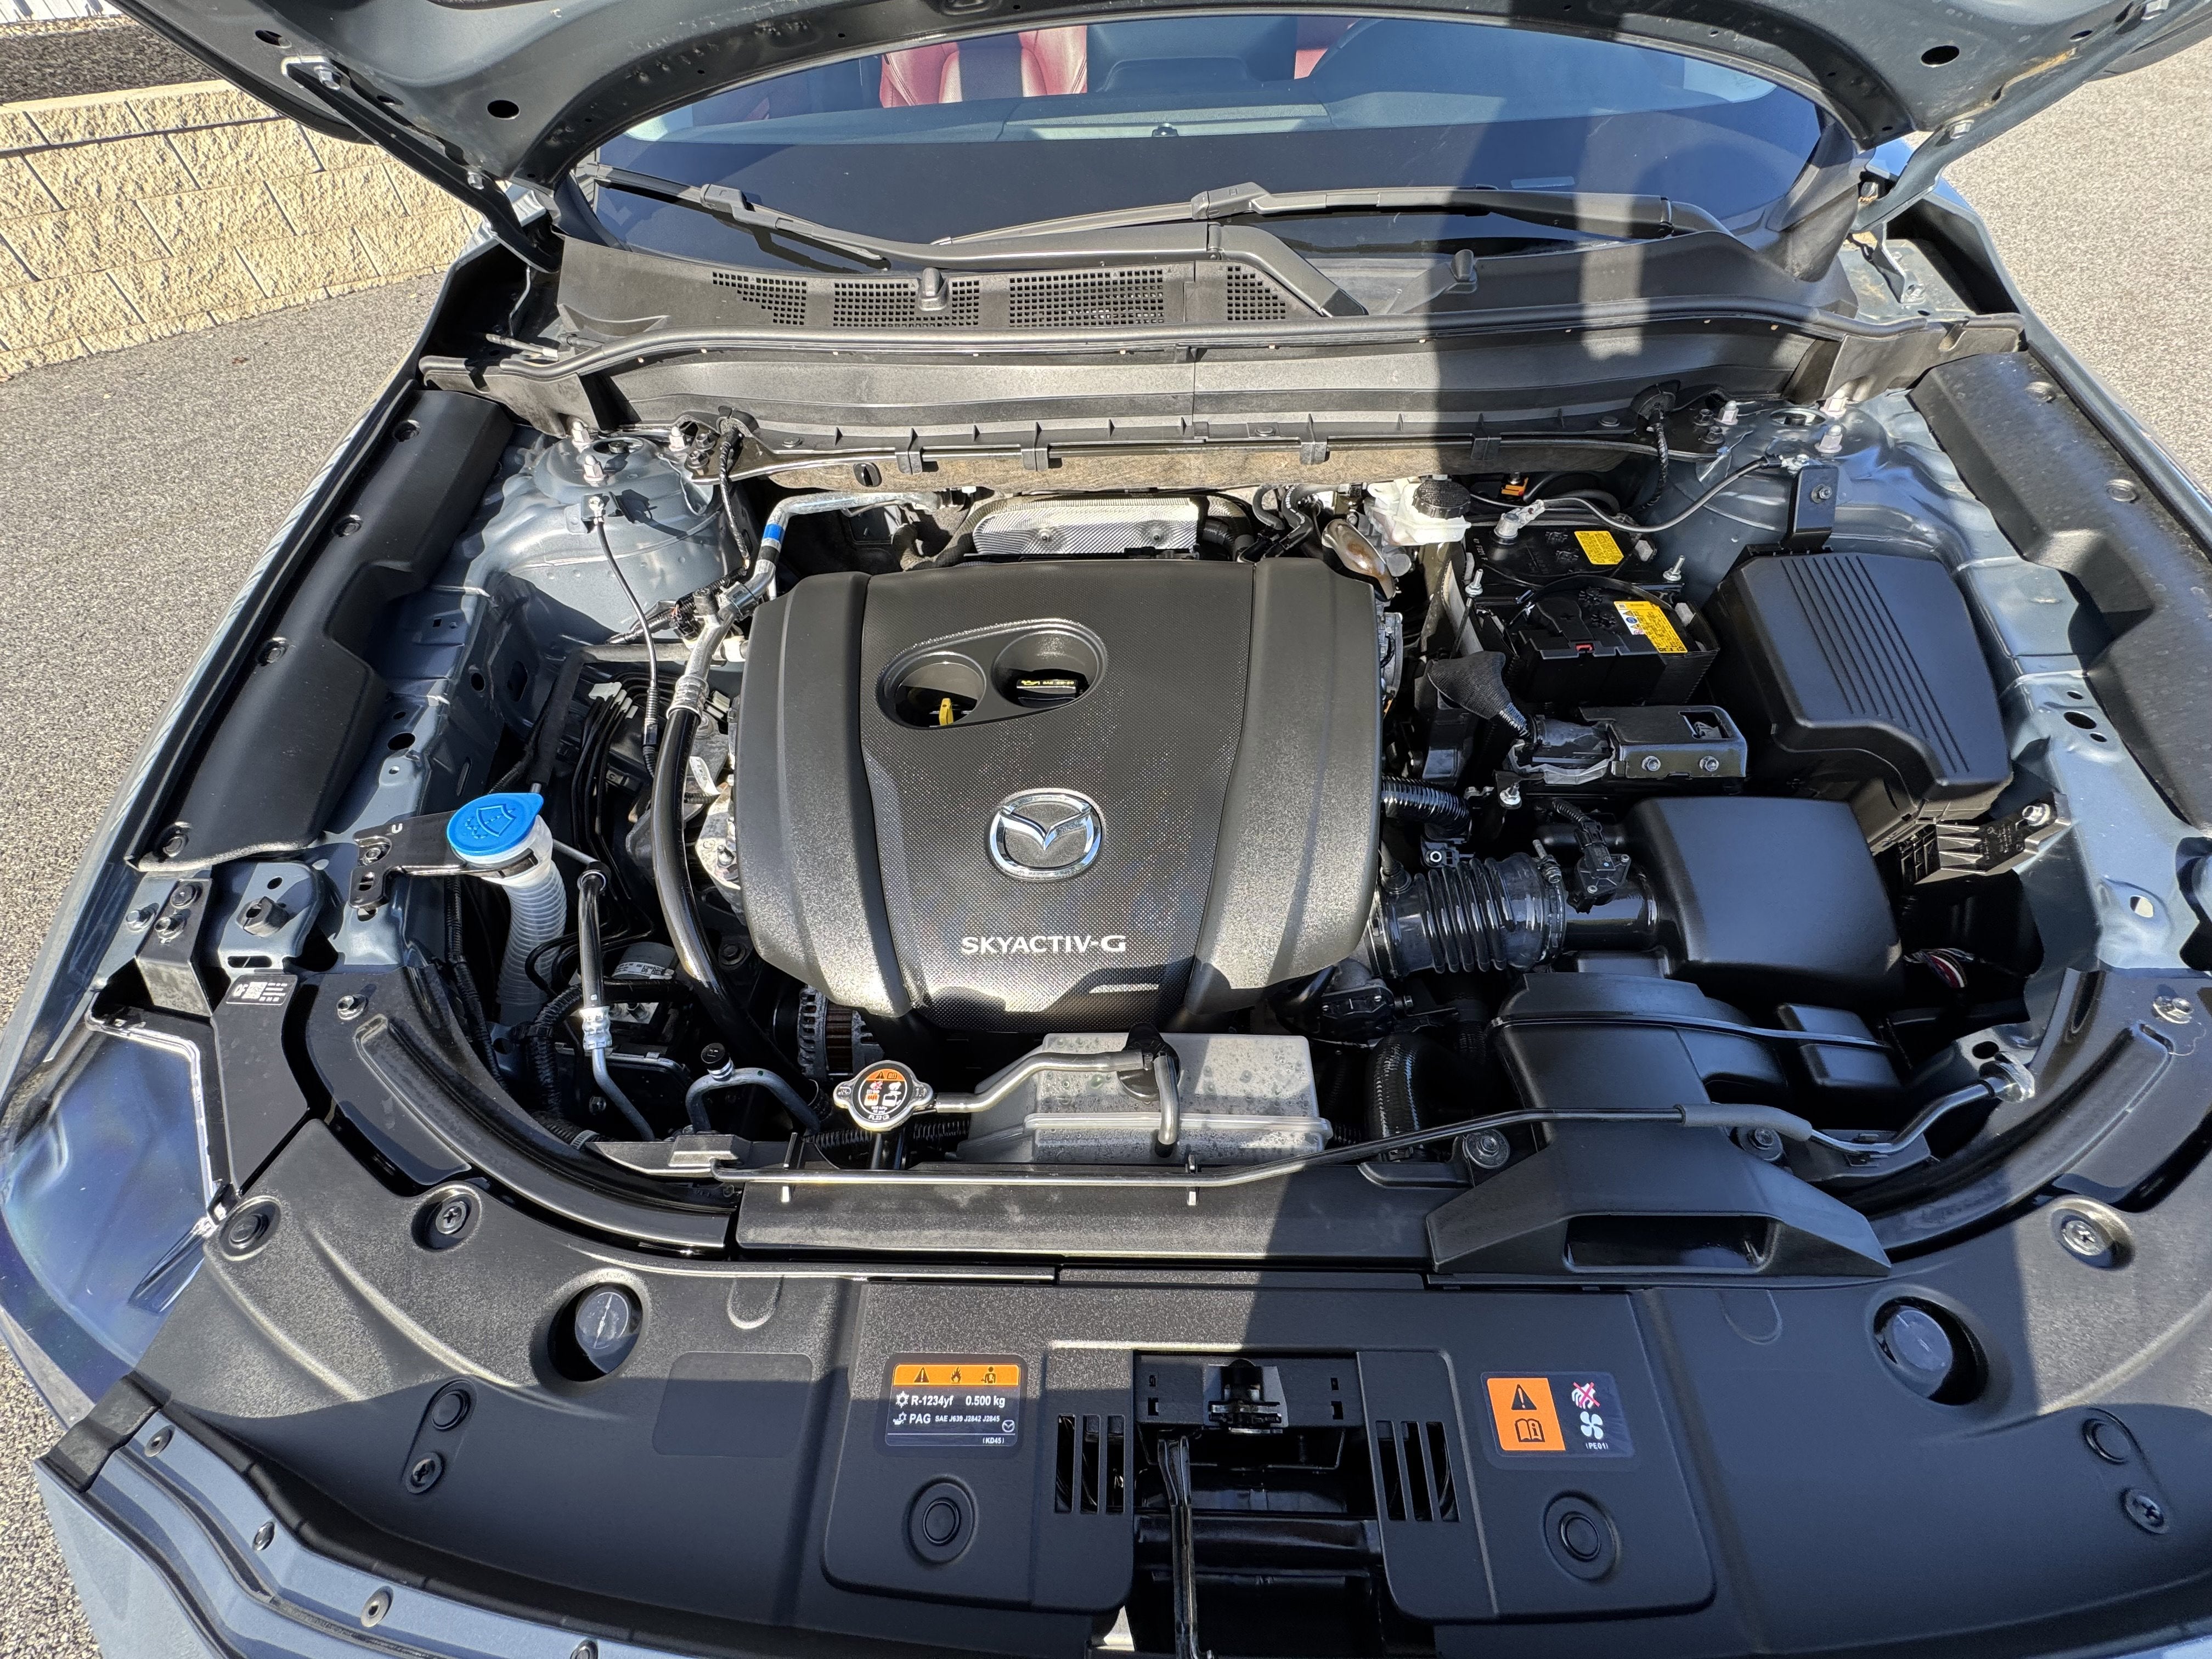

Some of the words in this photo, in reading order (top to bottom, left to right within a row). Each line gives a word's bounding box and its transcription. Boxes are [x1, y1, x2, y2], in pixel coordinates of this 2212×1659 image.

[961, 935, 1127, 955] SKYACTIV-G
[911, 1395, 954, 1408] R-1234yf
[966, 1395, 991, 1406] 0.500
[994, 1395, 1006, 1408] kg
[909, 1413, 931, 1424] PAG
